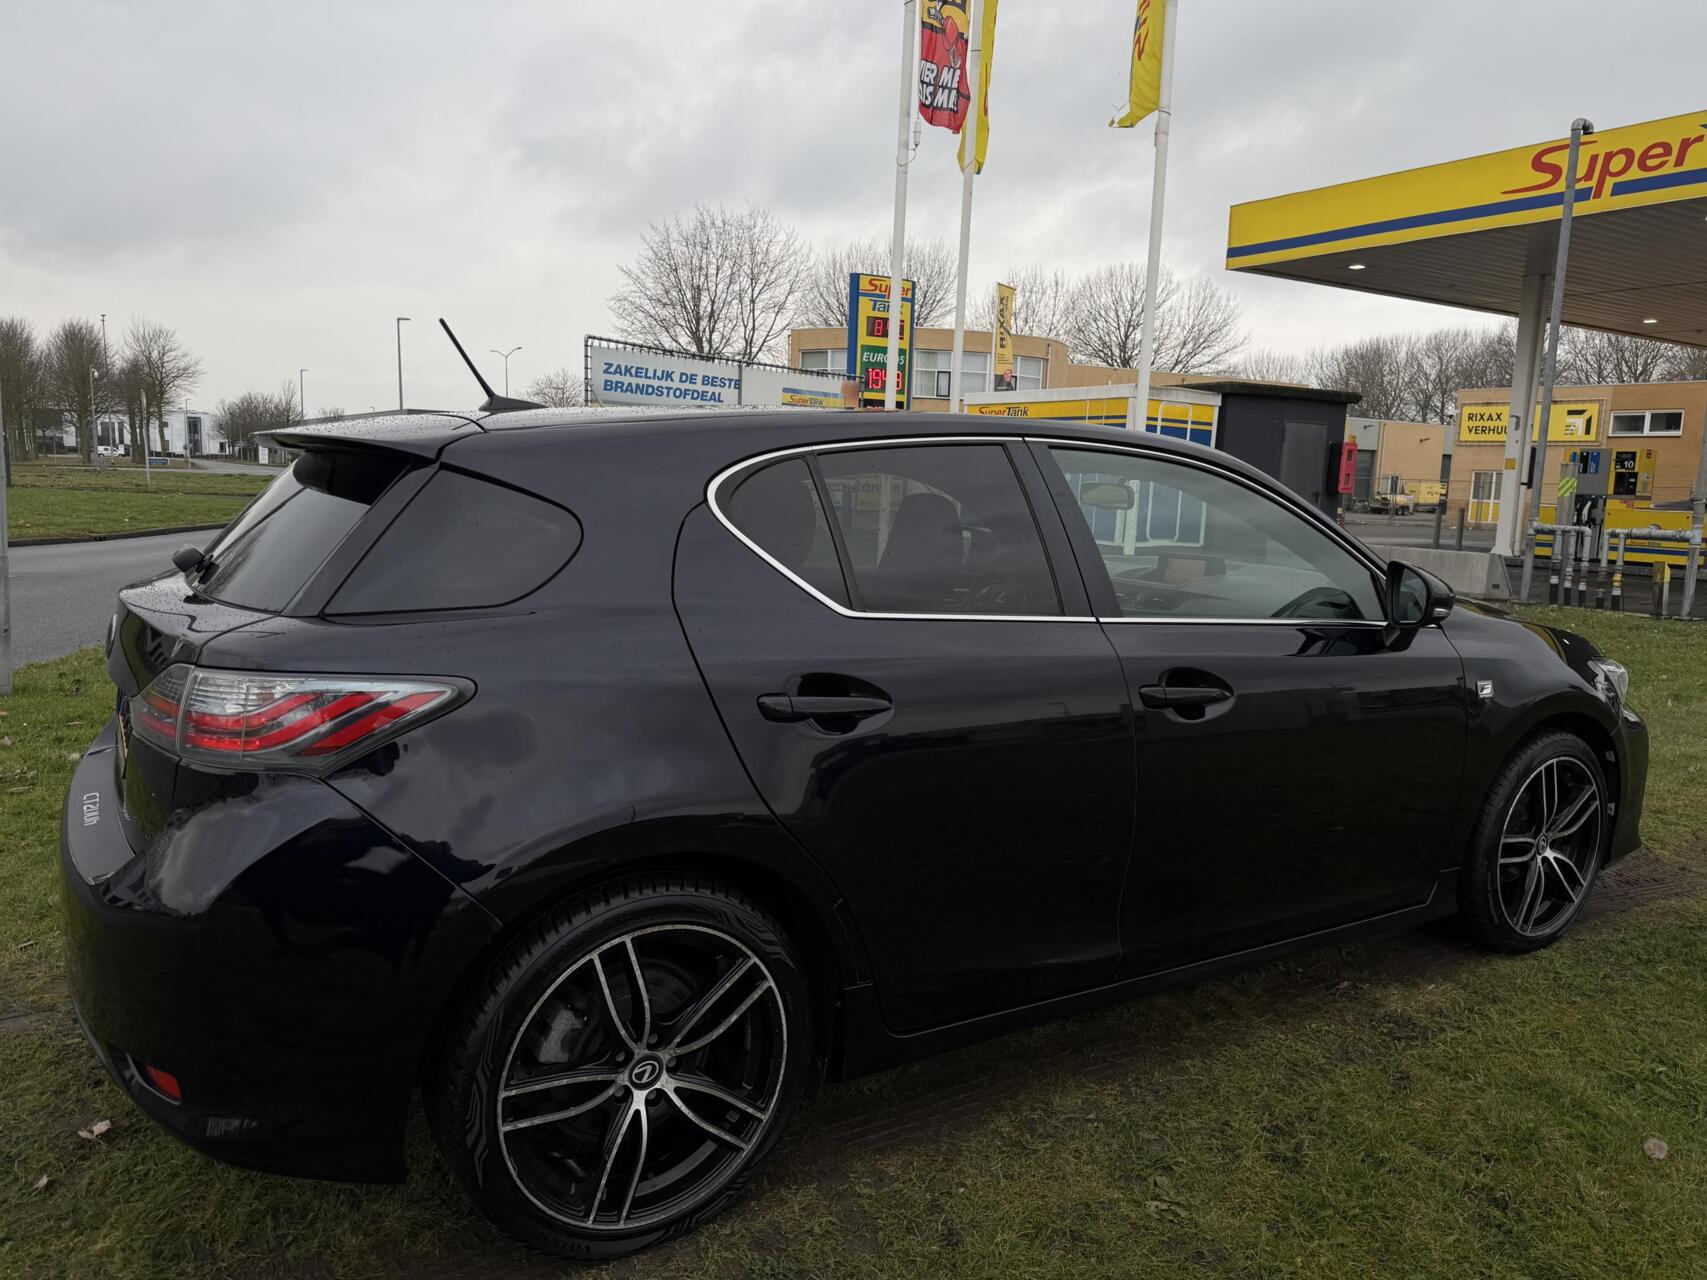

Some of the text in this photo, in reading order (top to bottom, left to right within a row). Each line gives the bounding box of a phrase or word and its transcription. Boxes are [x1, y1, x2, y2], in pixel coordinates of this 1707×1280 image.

[602, 362, 741, 390] ZAKELIJK DE BESTE
[602, 379, 725, 403] BRANDSTOFDEAL
[1467, 412, 1503, 422] RIXAX
[1623, 460, 1635, 469] 10
